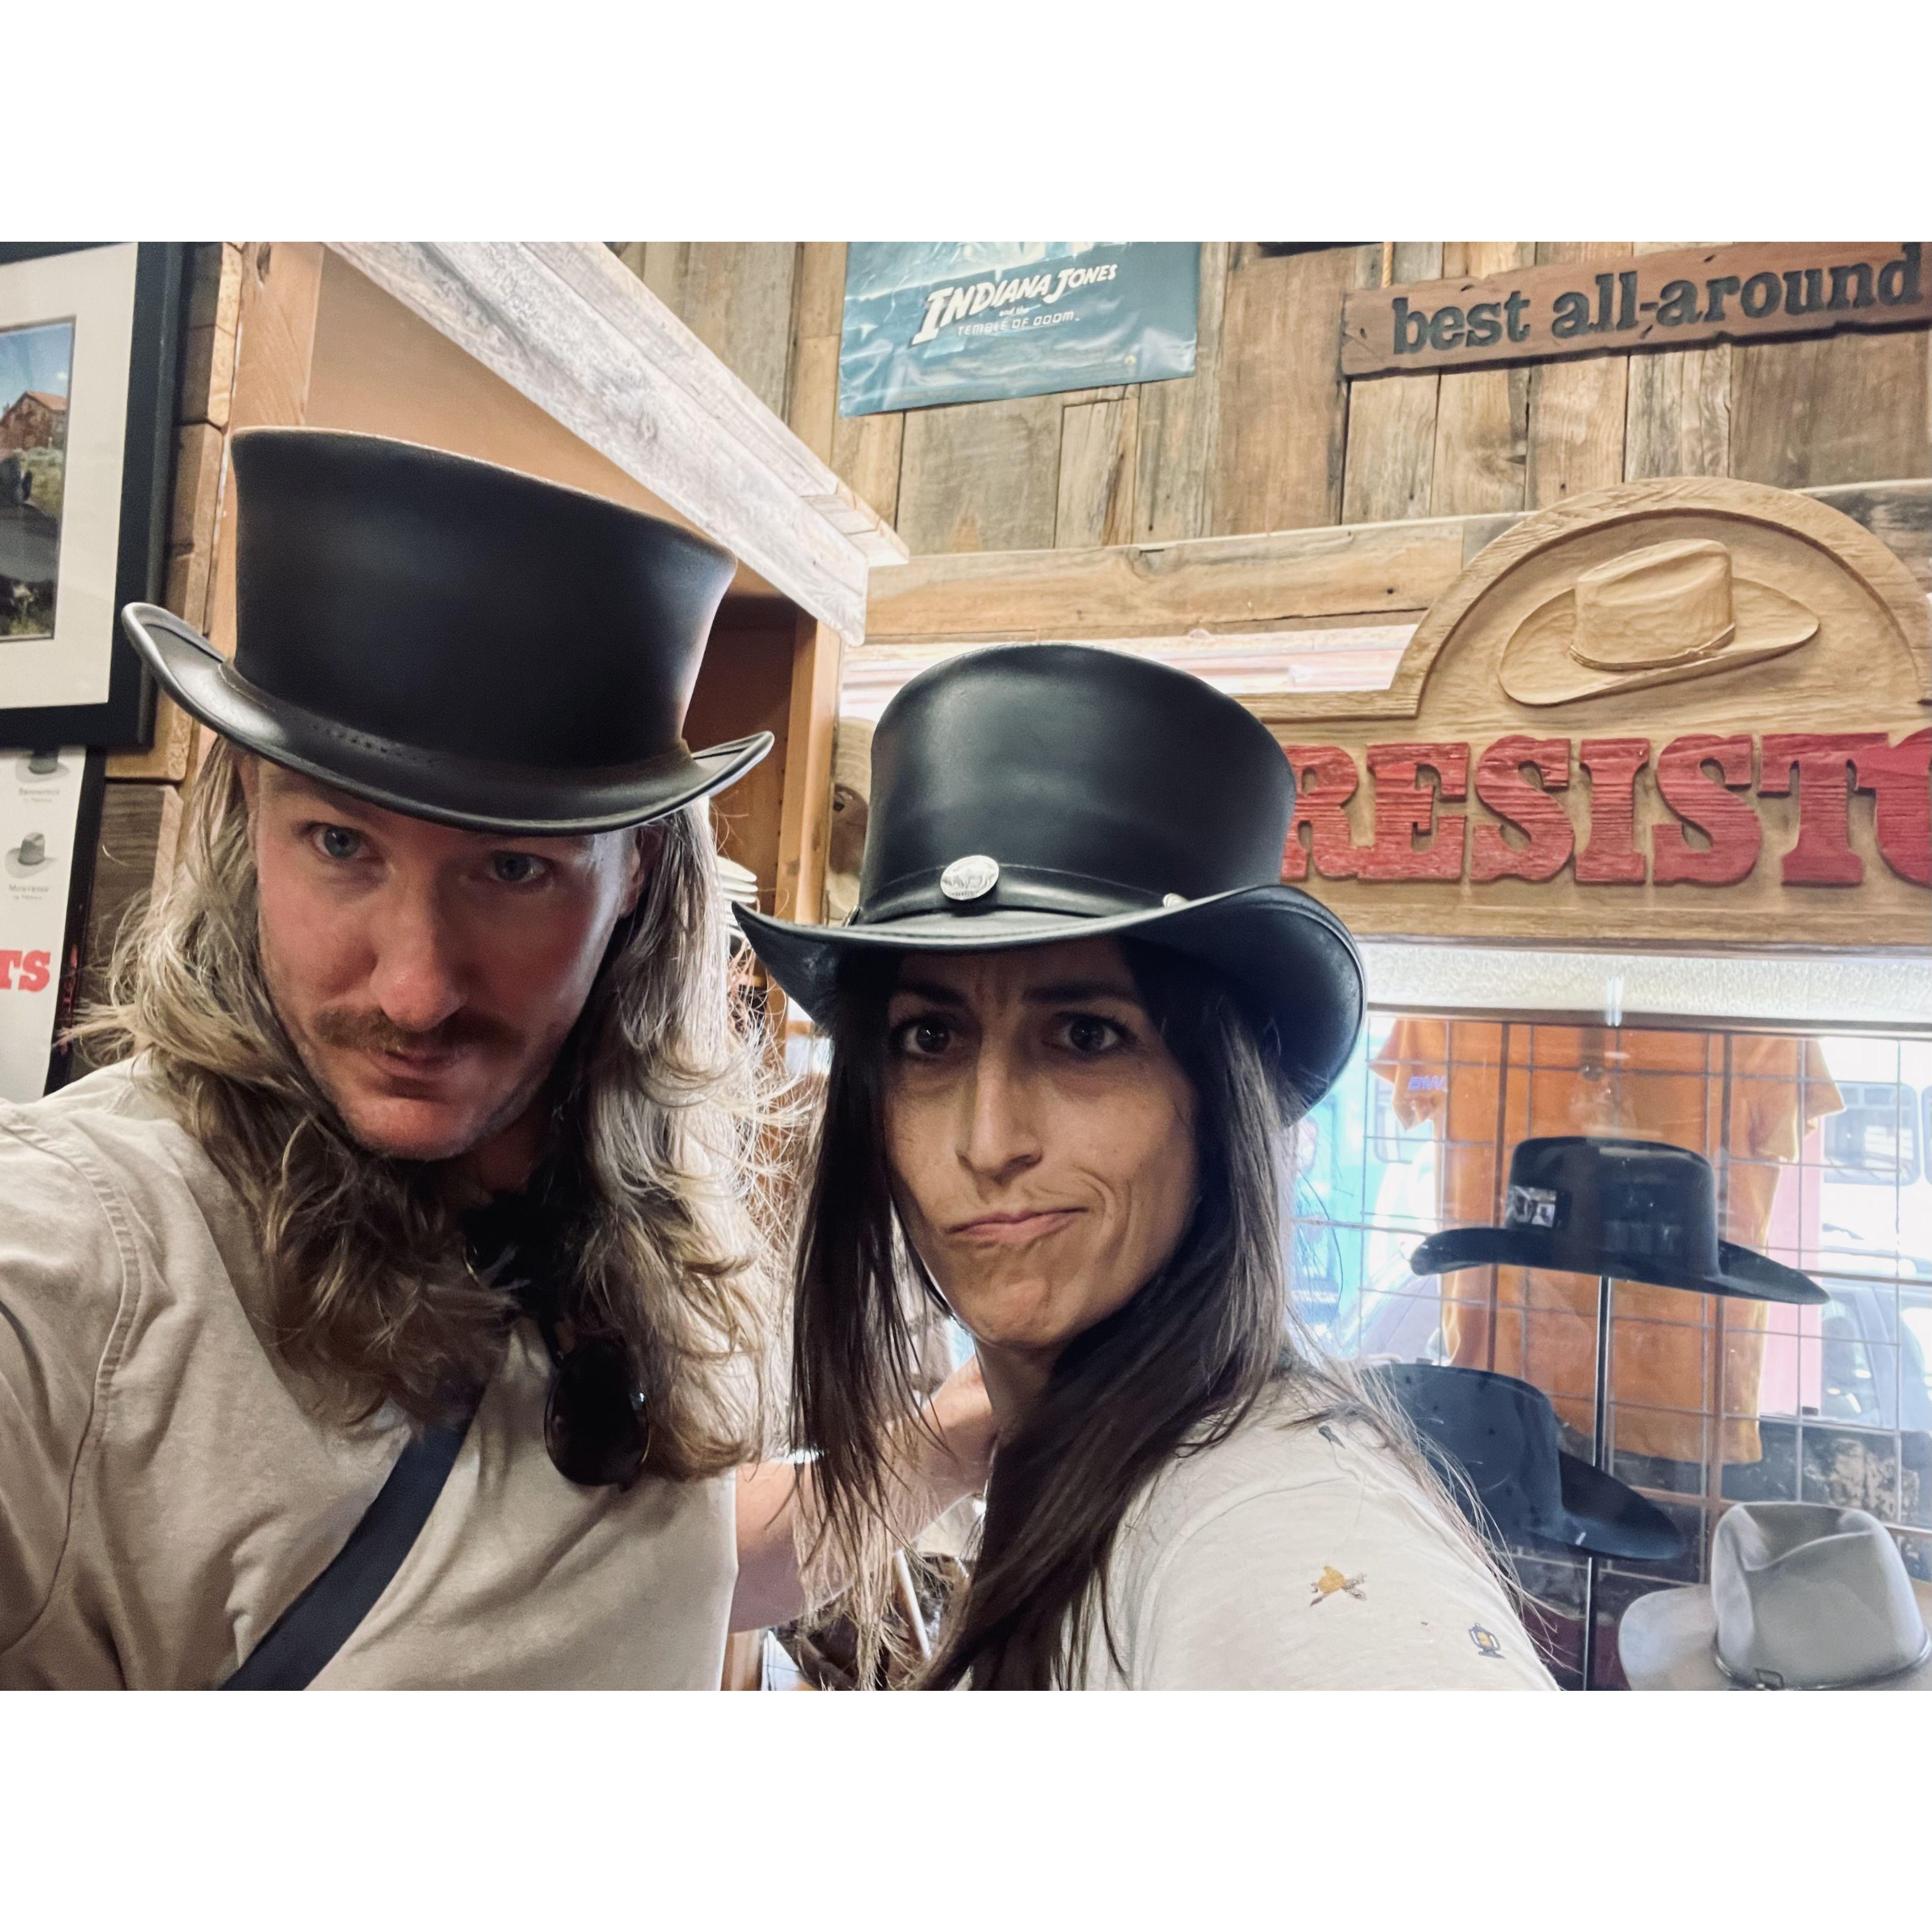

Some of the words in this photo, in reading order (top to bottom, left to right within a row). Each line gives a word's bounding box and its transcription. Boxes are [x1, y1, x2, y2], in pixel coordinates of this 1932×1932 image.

[911, 273, 1051, 345] INDIANA
[1043, 264, 1118, 304] JONES
[1011, 317, 1029, 329] OF
[1392, 290, 1530, 354] best
[1552, 241, 1923, 339] all-around
